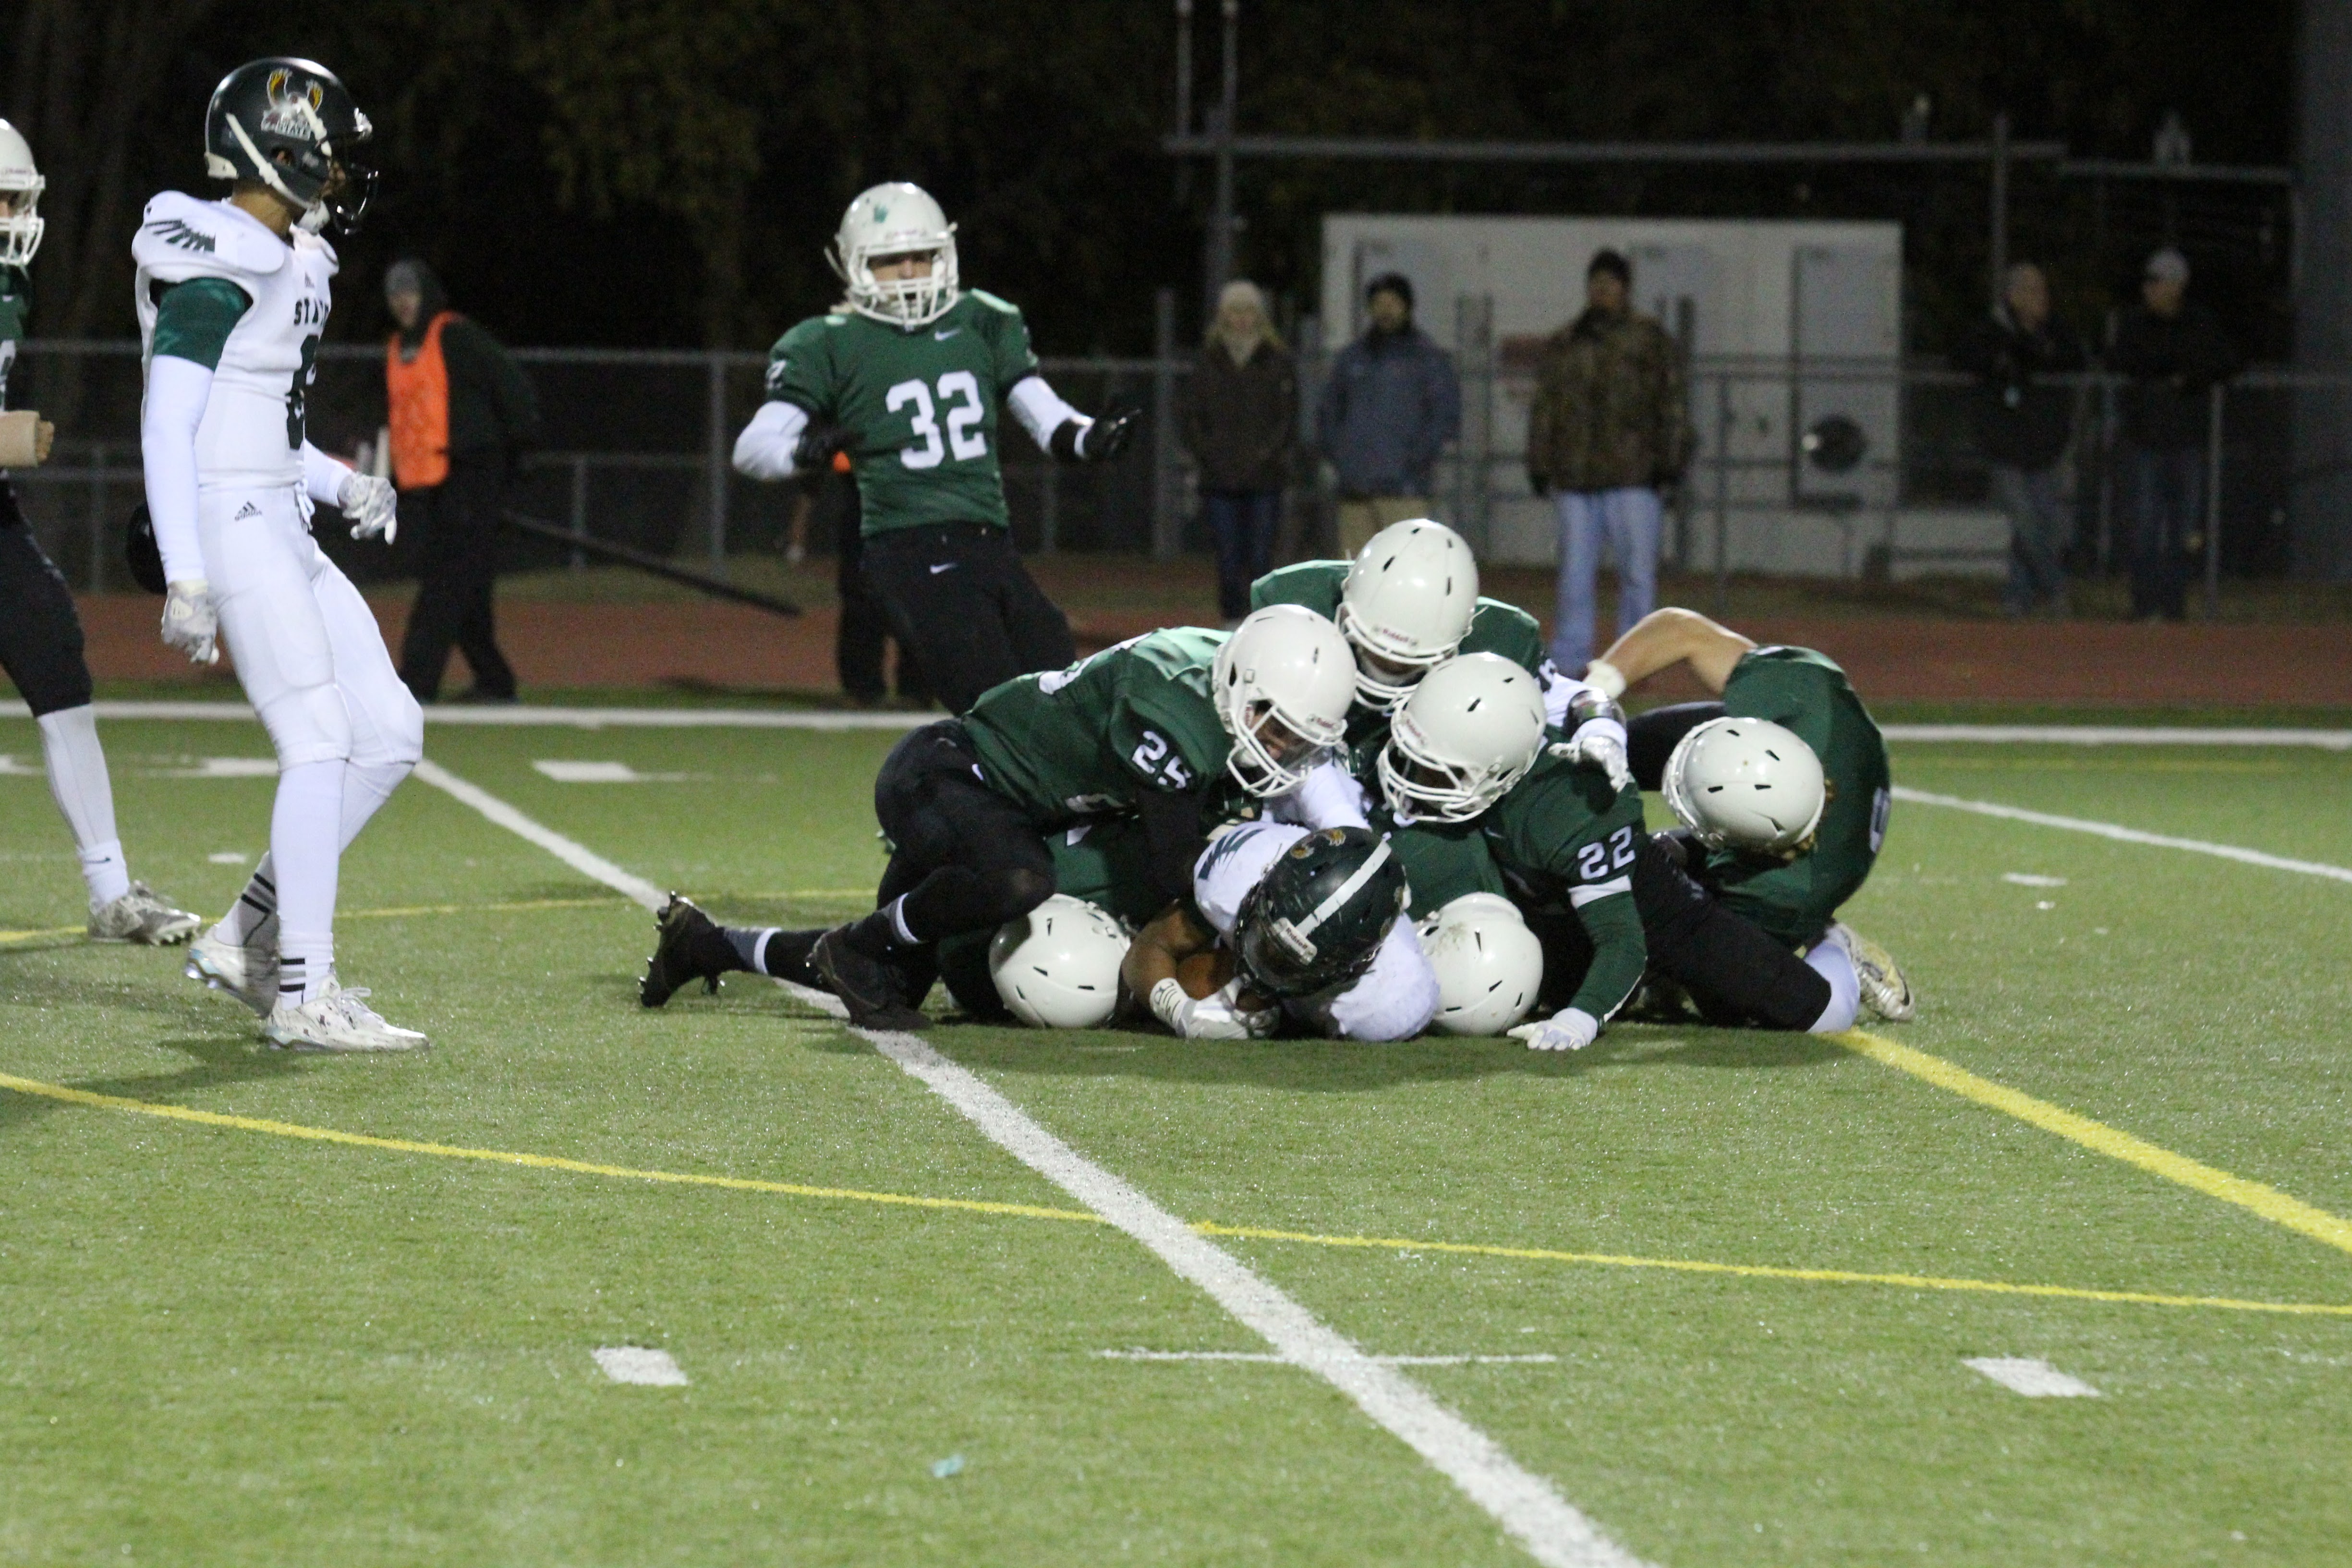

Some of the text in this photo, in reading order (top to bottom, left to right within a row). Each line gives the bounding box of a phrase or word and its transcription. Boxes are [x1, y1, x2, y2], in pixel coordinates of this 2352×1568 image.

[885, 370, 987, 469] 32
[1131, 730, 1191, 789] 25
[1577, 826, 1636, 880] 22
